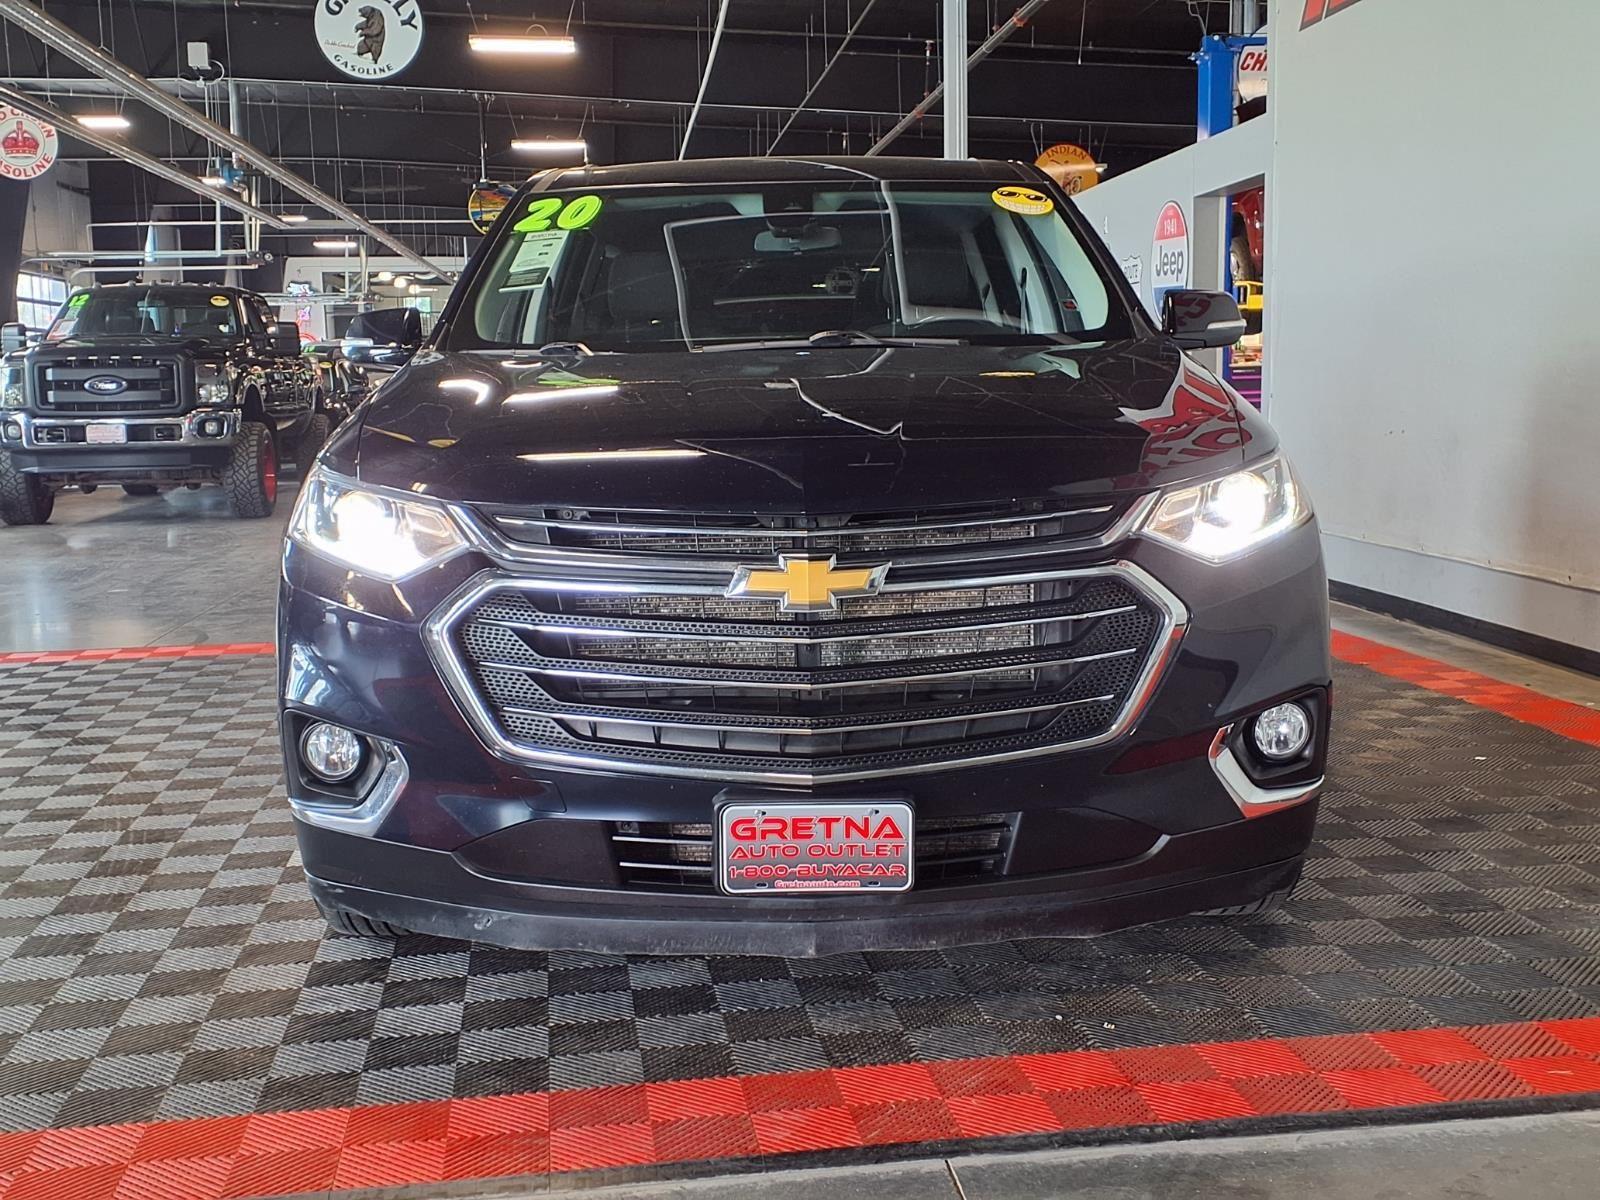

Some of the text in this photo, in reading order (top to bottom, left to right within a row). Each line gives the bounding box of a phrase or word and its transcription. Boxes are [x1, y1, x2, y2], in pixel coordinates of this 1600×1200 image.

[334, 54, 394, 75] GASOLINE
[1240, 52, 1267, 71] CH
[1046, 146, 1087, 160] INDIAN
[513, 195, 602, 232] 20
[1164, 218, 1177, 236] 1941
[1155, 245, 1184, 282] Jeep
[69, 294, 90, 308] 12
[730, 815, 905, 842] GRETNA
[728, 843, 906, 860] AUTO OUTLET
[729, 863, 906, 878] 1-800-BUYACAR
